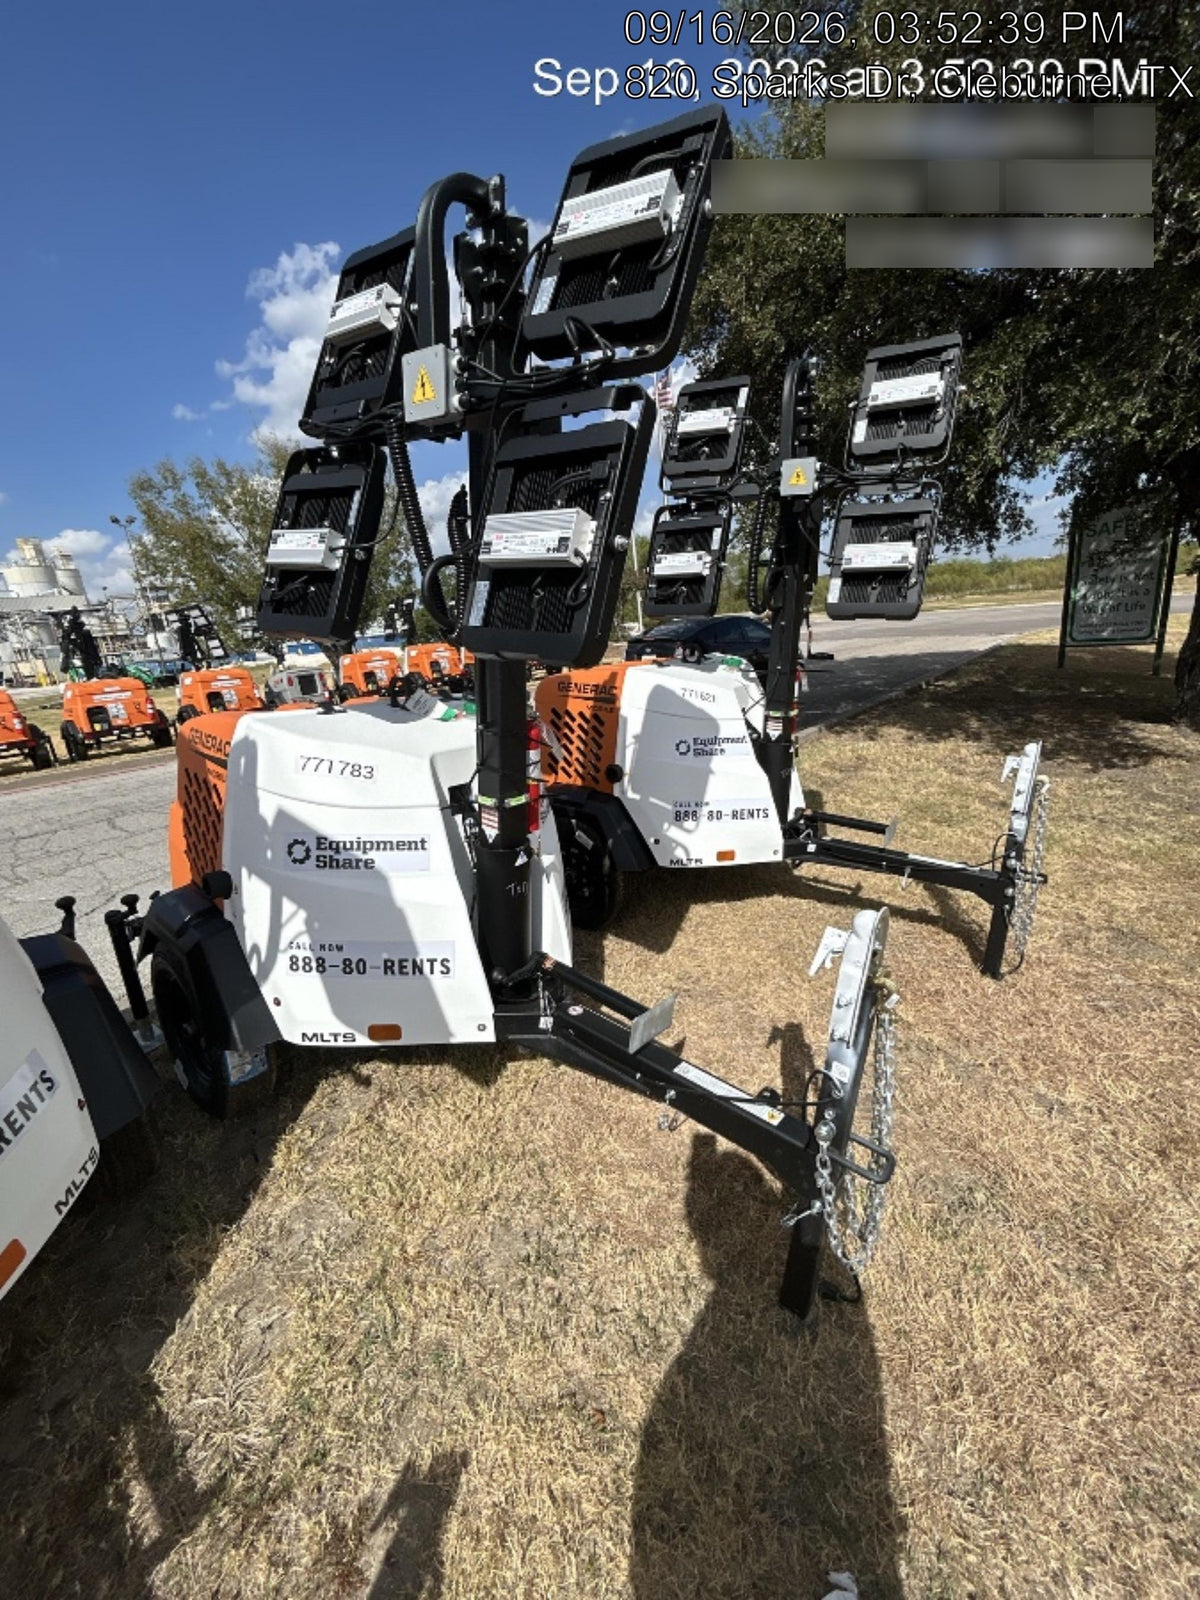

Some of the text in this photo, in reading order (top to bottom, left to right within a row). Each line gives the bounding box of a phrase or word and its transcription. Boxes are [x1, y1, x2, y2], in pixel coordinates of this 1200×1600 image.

[558, 681, 618, 697] GENERAC
[693, 735, 749, 747] Equipment
[693, 747, 726, 758] Share
[300, 754, 375, 780] 771783
[674, 807, 769, 822] 888-80-RENTS
[315, 836, 428, 855] Equipment
[315, 855, 376, 870] Share
[289, 941, 345, 952] CALL NOW
[288, 954, 452, 977] 888-80-RENTS
[301, 1032, 357, 1043] MLTS
[54, 1146, 98, 1216] MLTS
